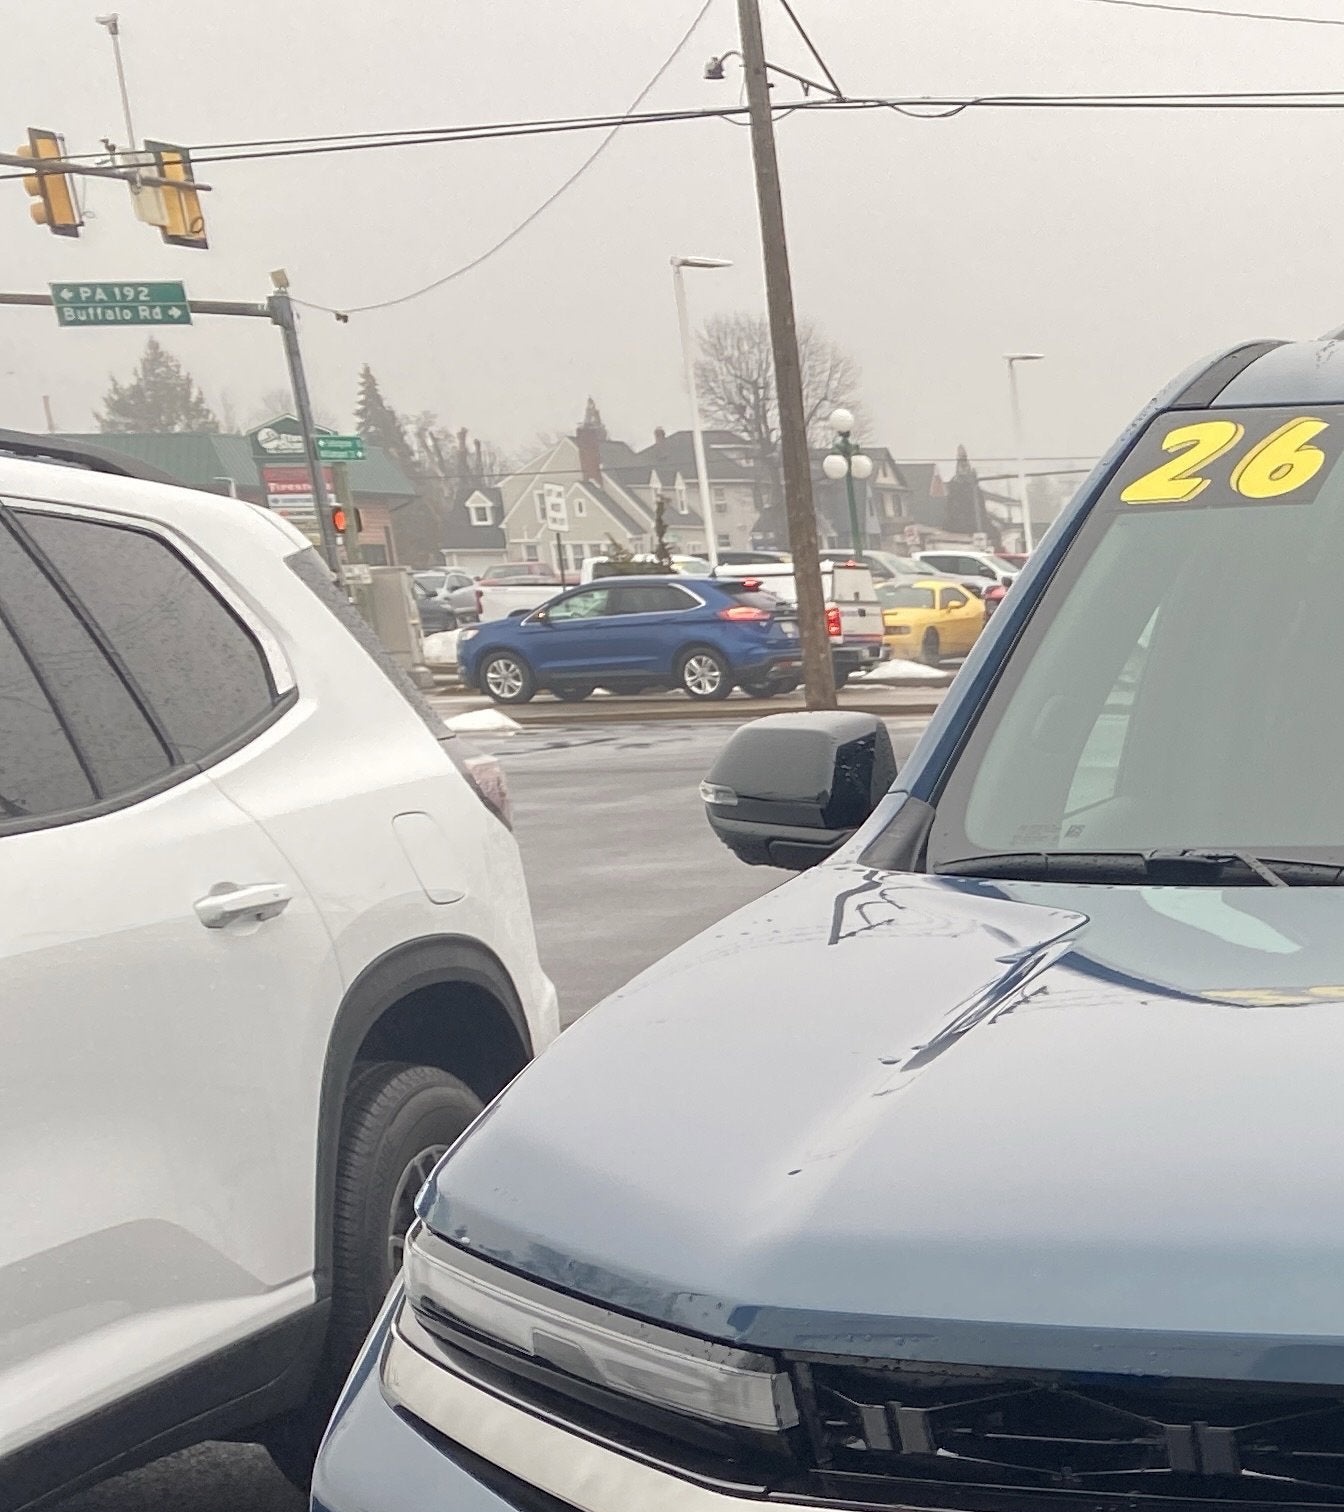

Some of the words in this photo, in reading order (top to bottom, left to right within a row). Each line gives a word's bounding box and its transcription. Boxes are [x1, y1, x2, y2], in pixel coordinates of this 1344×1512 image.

[79, 286, 108, 301] PA
[113, 286, 150, 301] 192
[63, 306, 132, 321] Buffalo
[138, 305, 162, 320] Rd
[1120, 416, 1330, 504] 26
